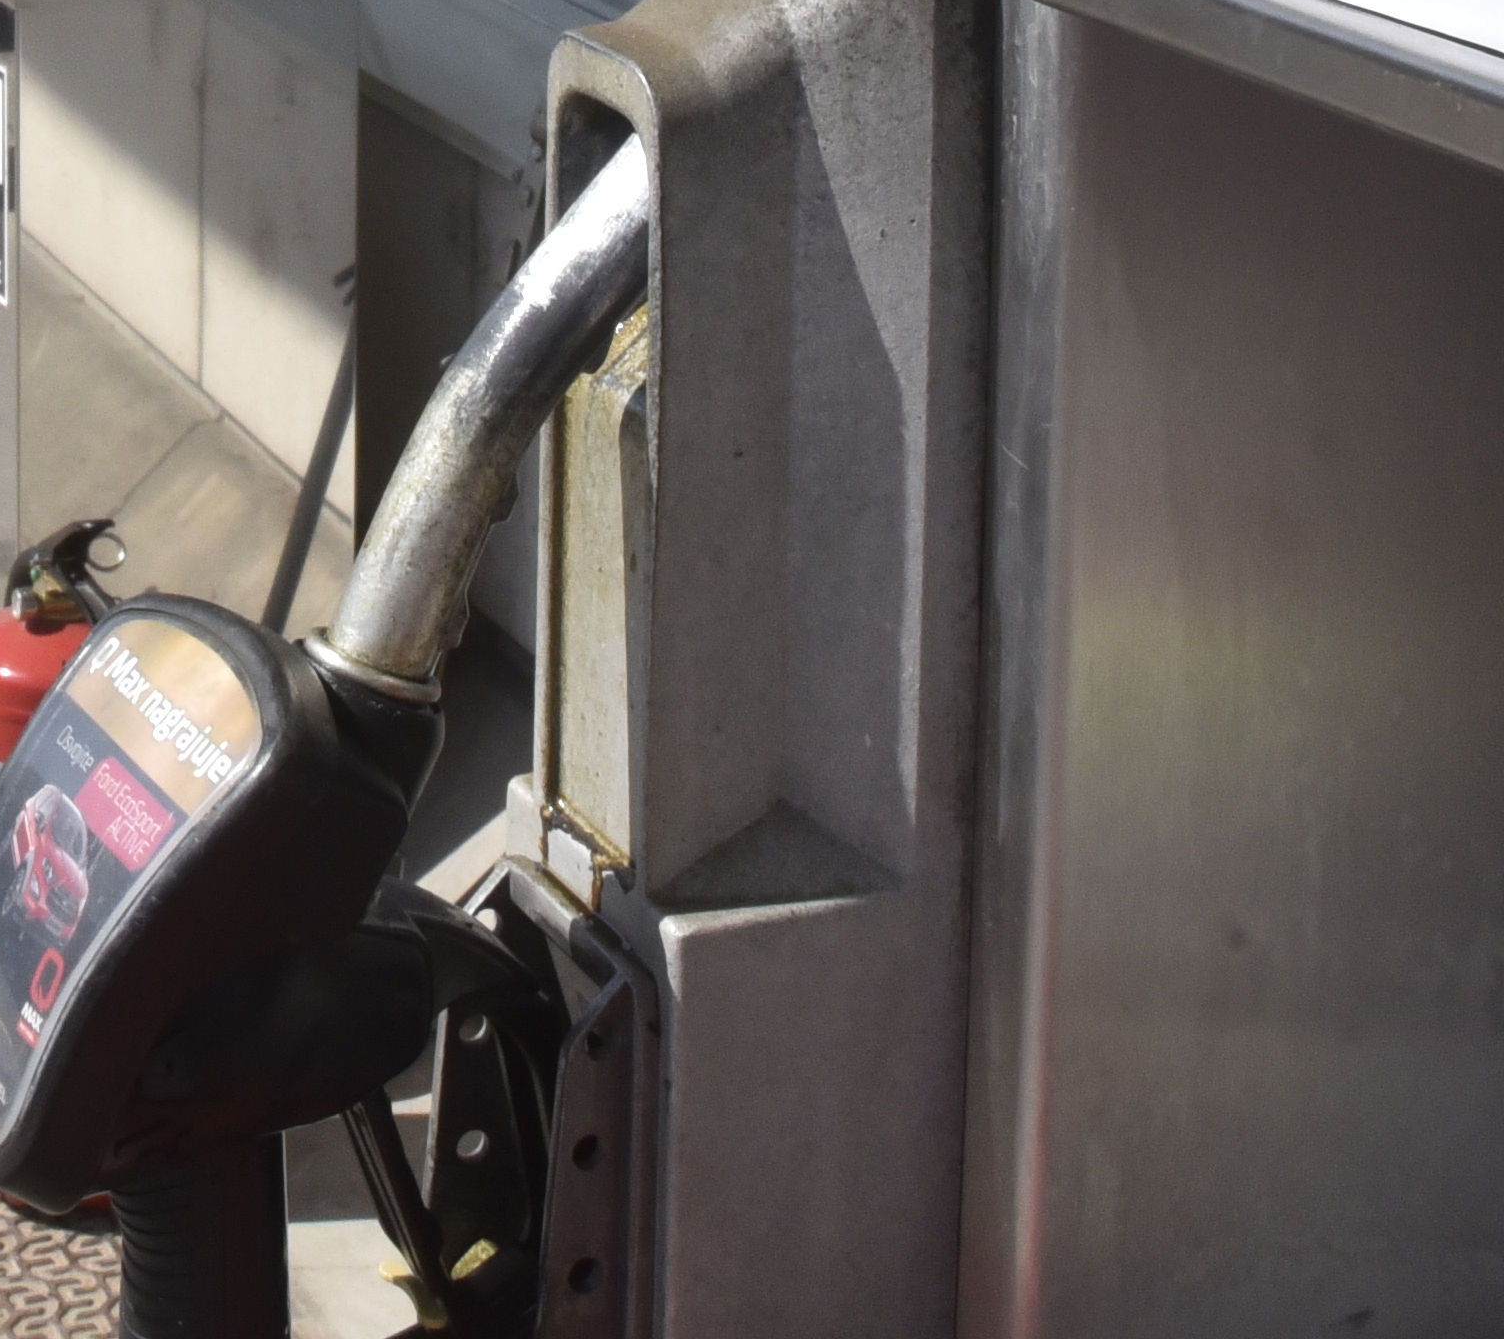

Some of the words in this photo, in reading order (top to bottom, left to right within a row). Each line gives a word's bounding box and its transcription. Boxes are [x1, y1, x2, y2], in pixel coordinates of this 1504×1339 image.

[89, 636, 121, 675] Q
[103, 648, 150, 705] Max
[56, 724, 95, 773] Osvojite
[139, 688, 233, 785] nagrajuje
[93, 762, 120, 799] Ford
[113, 783, 163, 842] EcoSport
[105, 814, 152, 864] ACTIVE
[20, 1000, 44, 1033] MAX
